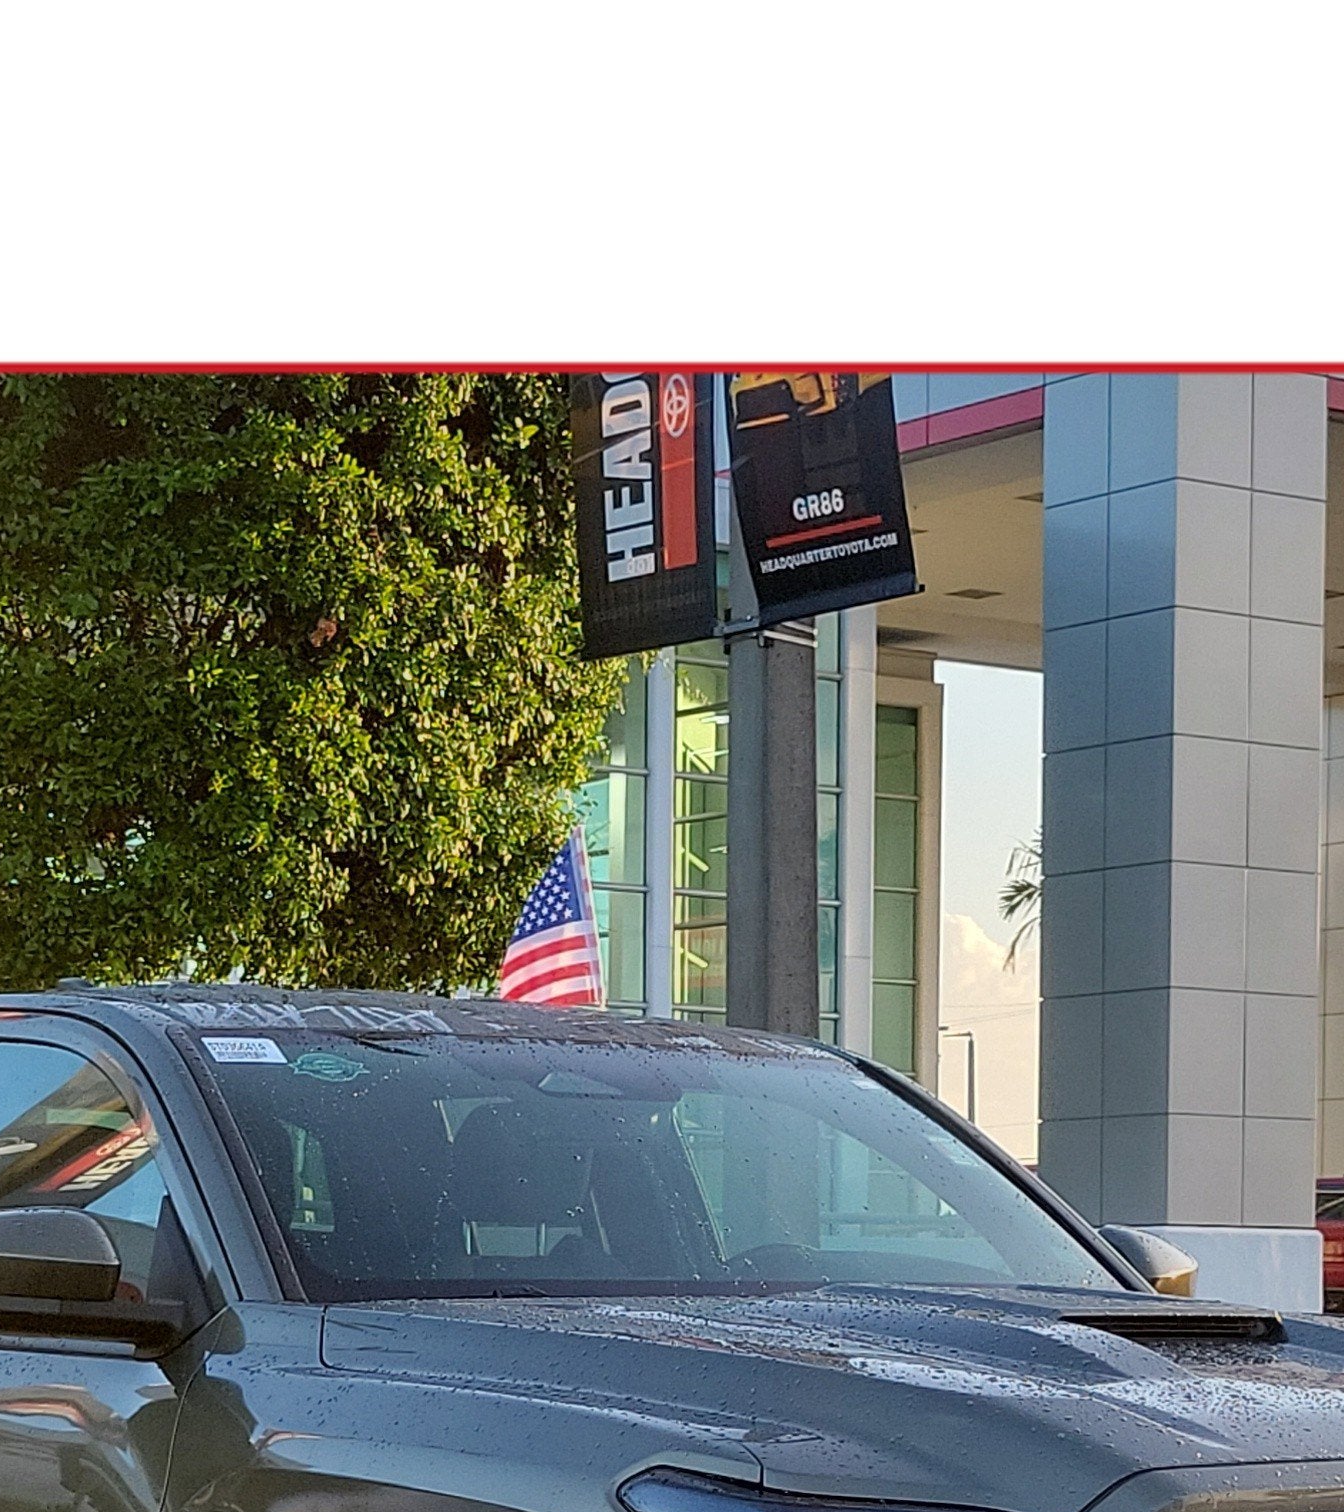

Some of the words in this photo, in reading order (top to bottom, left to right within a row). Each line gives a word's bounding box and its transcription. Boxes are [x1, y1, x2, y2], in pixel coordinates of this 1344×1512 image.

[602, 373, 656, 582] HEAD
[793, 489, 844, 521] GR86
[760, 533, 897, 574] HEADQUARTERTOYOTA.COM
